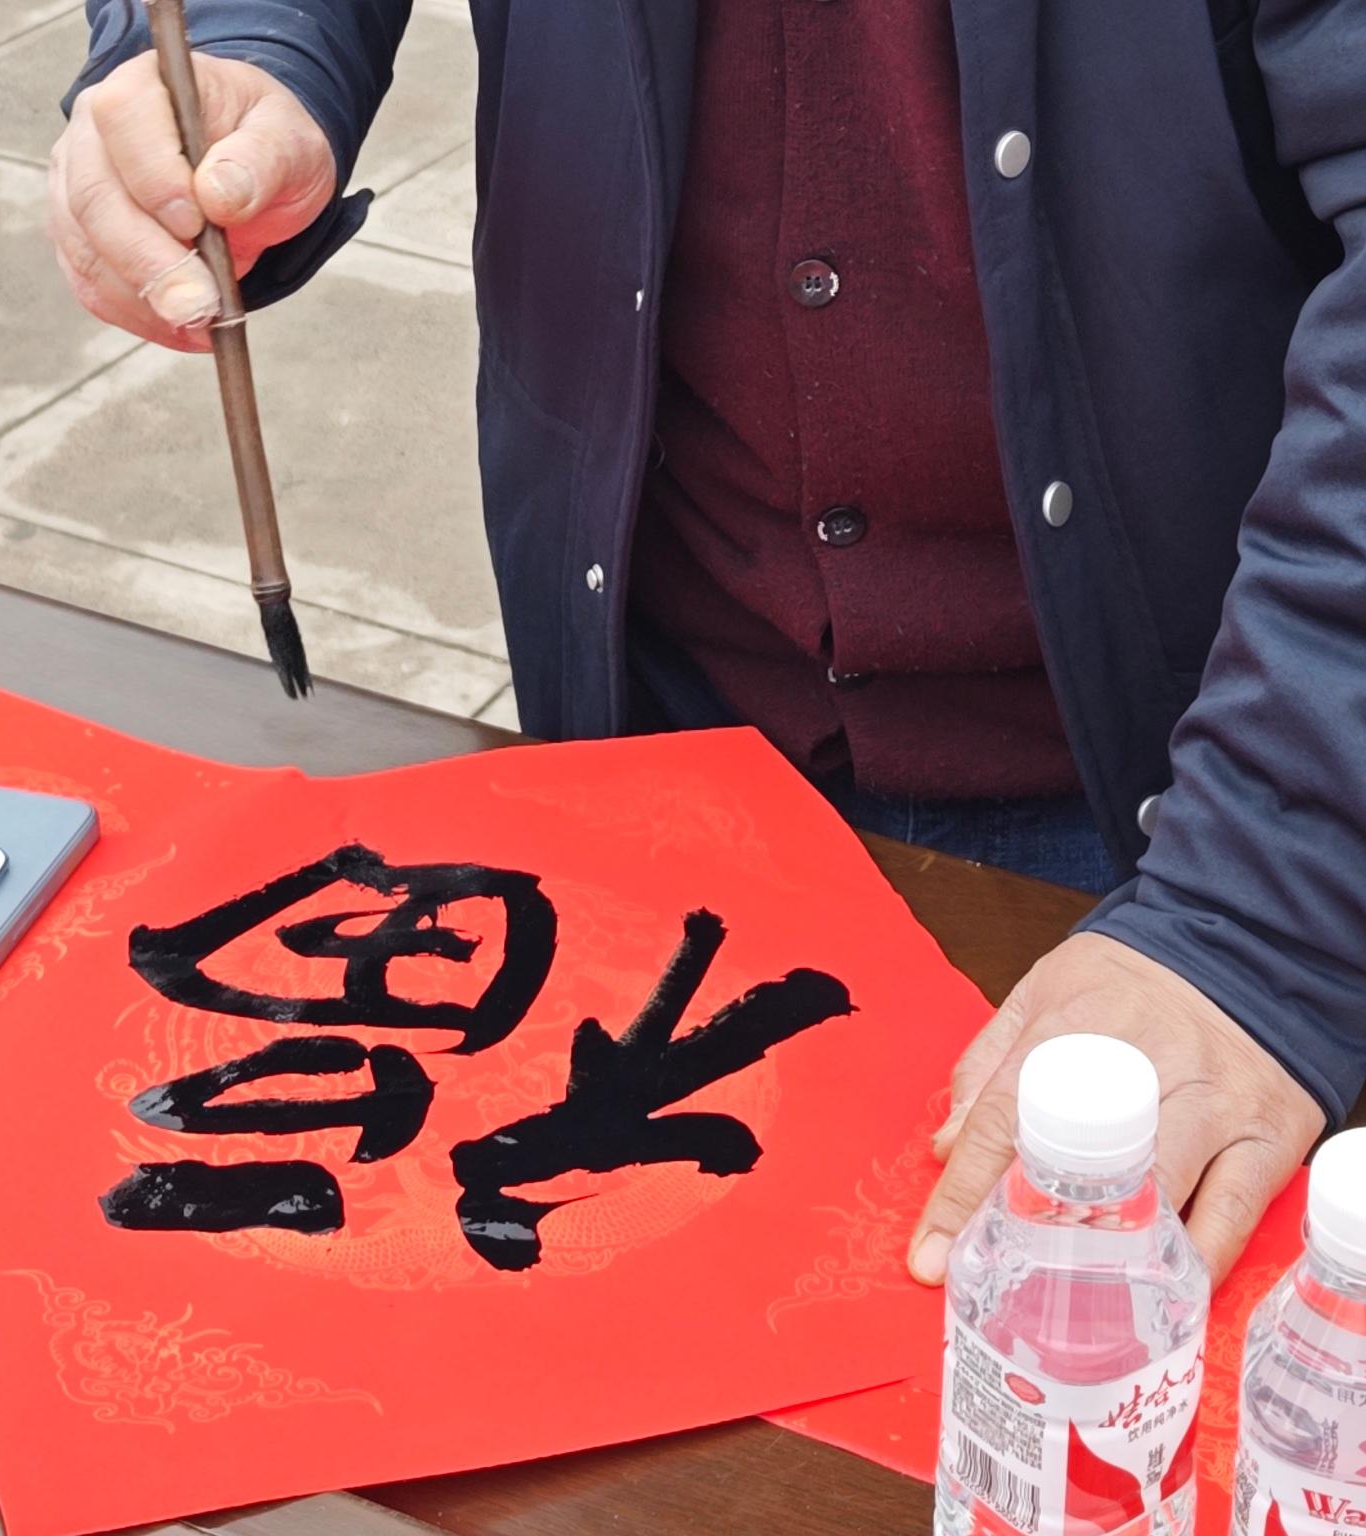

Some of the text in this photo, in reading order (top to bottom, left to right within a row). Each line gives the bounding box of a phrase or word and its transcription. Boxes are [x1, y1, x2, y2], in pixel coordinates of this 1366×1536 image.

[1127, 1398, 1189, 1444] 饮用纯净水
